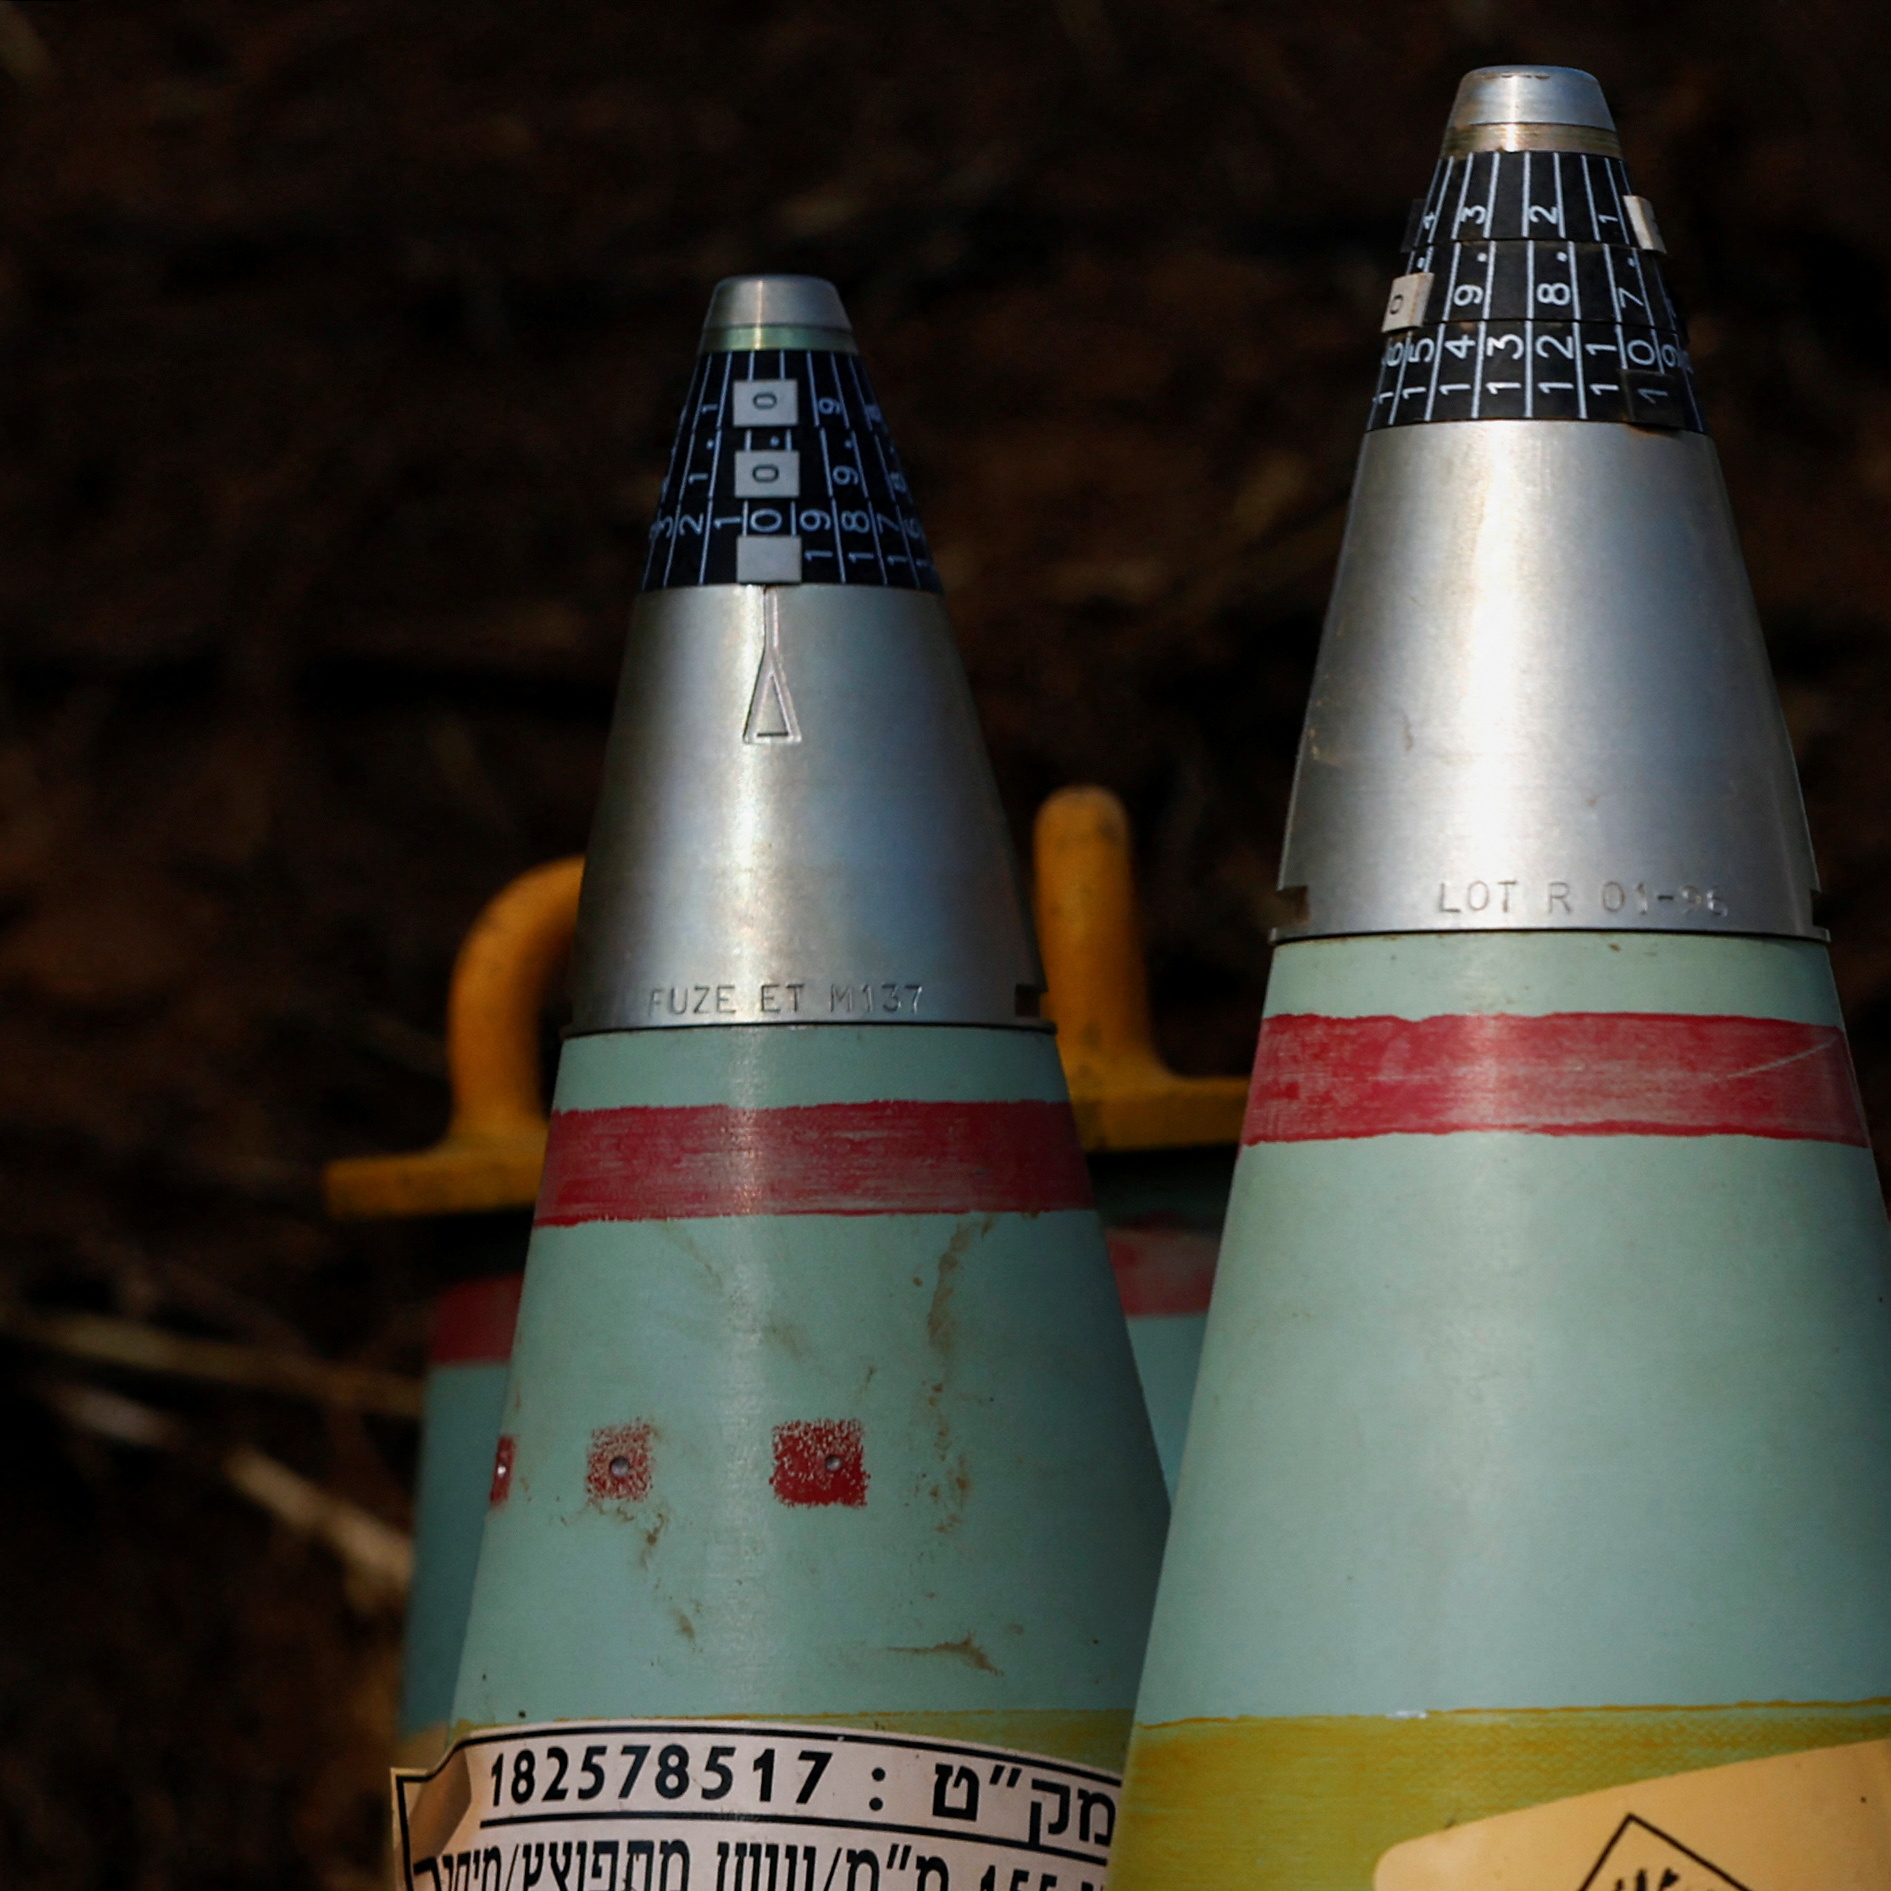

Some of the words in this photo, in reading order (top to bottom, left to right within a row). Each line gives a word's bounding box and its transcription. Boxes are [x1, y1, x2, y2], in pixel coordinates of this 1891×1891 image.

[1460, 203, 1488, 226] 3
[1528, 203, 1559, 225] 2
[751, 391, 778, 412] 0
[818, 396, 841, 416] 9
[1437, 880, 1518, 914] LOT
[1547, 880, 1573, 914] R
[648, 985, 737, 1016] FUZE
[759, 983, 805, 1014] ET
[829, 984, 925, 1014] M137
[490, 1743, 833, 1807] 182578517
